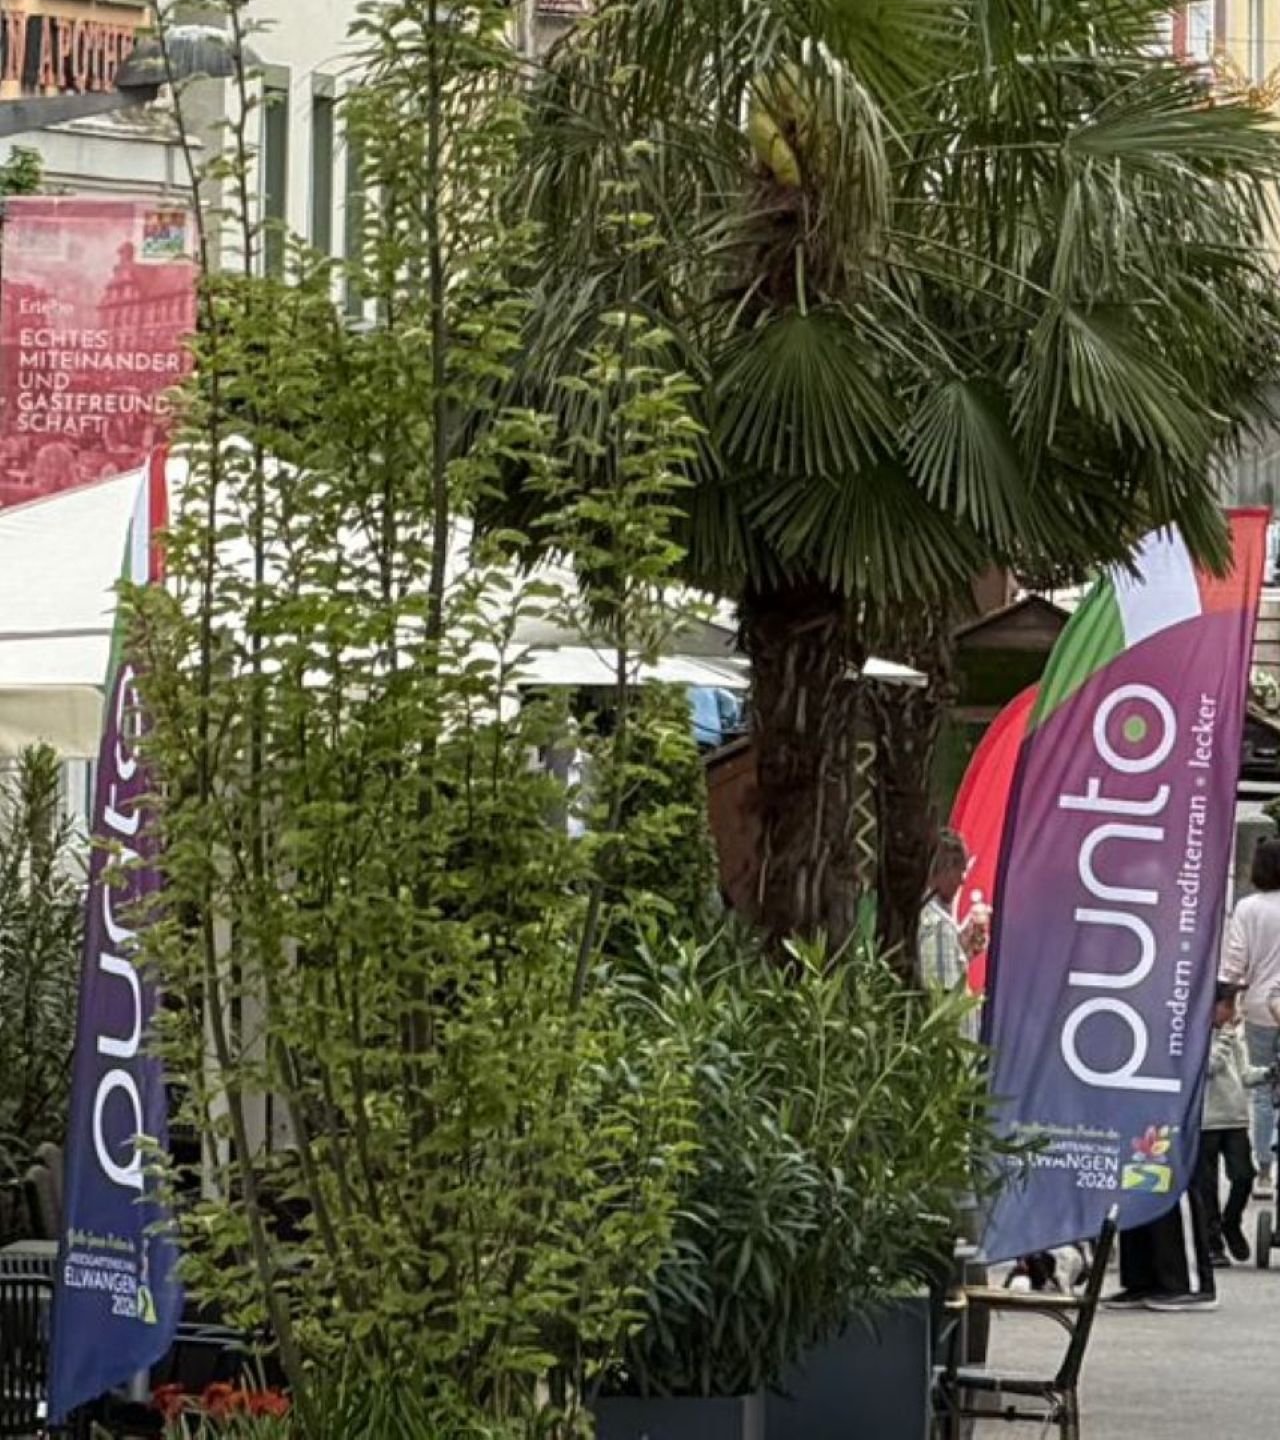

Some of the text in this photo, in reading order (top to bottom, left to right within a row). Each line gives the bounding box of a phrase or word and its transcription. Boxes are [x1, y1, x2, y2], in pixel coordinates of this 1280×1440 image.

[19, 328, 109, 350] ECHTES
[19, 350, 181, 372] MITEINANDER
[18, 372, 71, 391] UND
[17, 391, 171, 414] GASTFREUND
[17, 413, 106, 433] SCHAFT
[1168, 692, 1217, 1058] modern mediterran lecker
[1057, 683, 1182, 1093] punto
[1075, 1171, 1118, 1190] 2026
